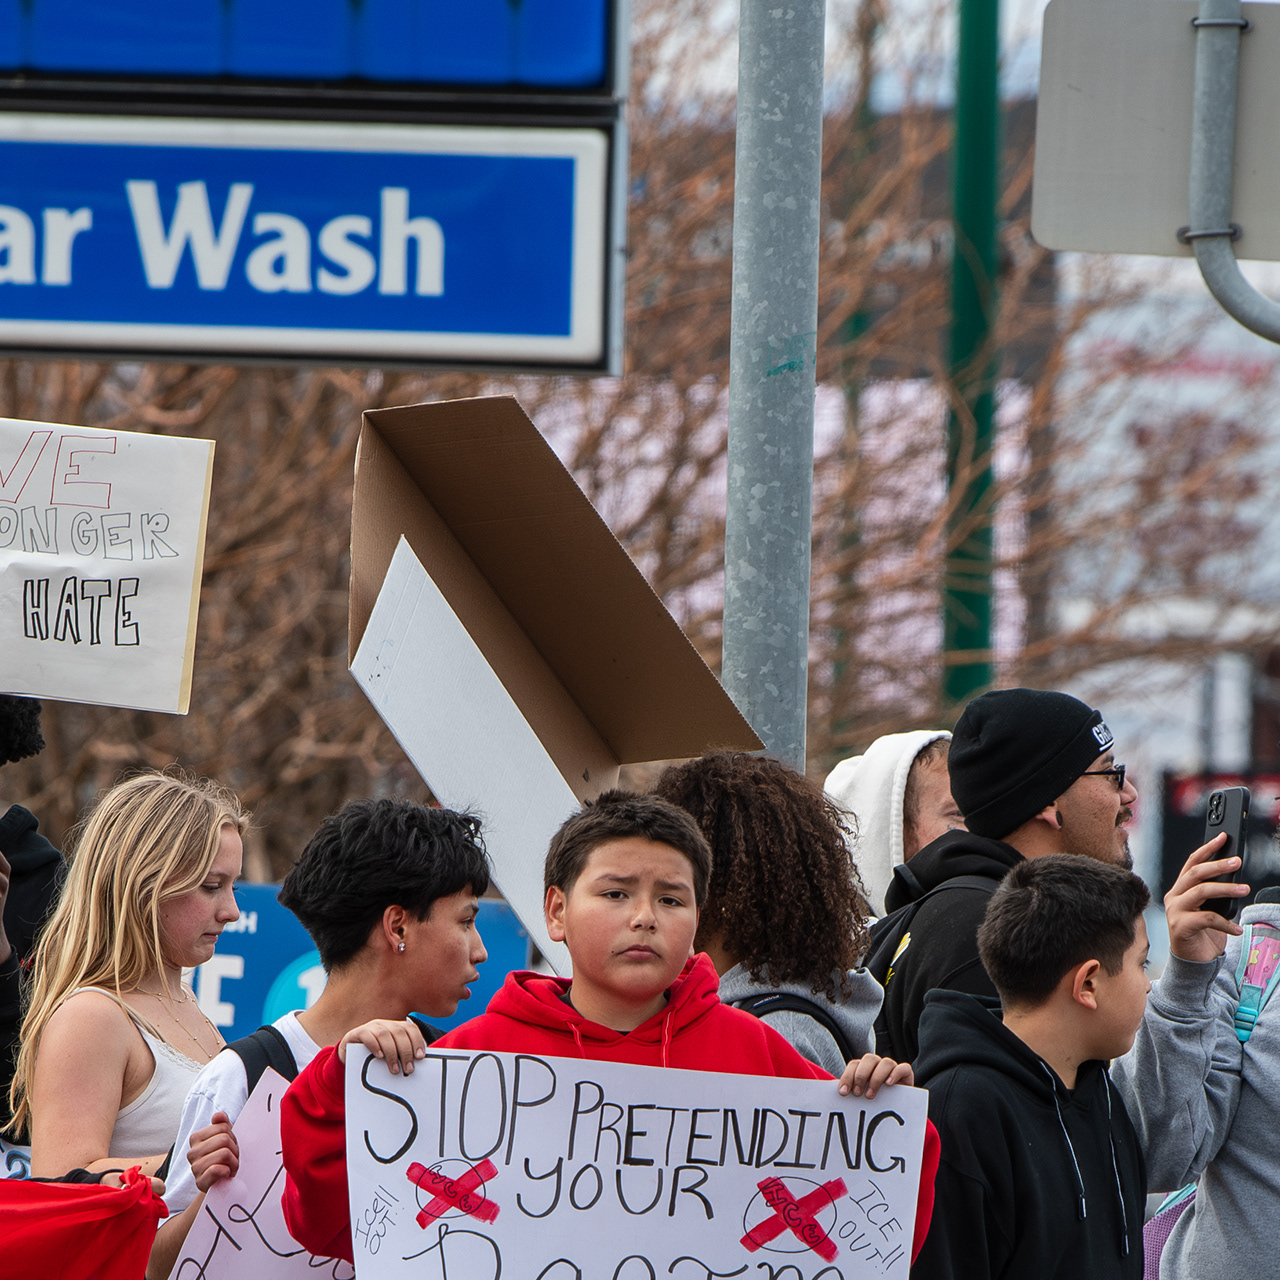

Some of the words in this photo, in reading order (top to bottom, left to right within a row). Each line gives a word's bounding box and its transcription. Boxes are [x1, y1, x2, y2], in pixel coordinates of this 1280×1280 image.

[126, 181, 445, 297] Wash
[22, 576, 141, 647] HATE
[361, 1052, 558, 1165] STOP
[567, 1080, 907, 1174] PRETENDING
